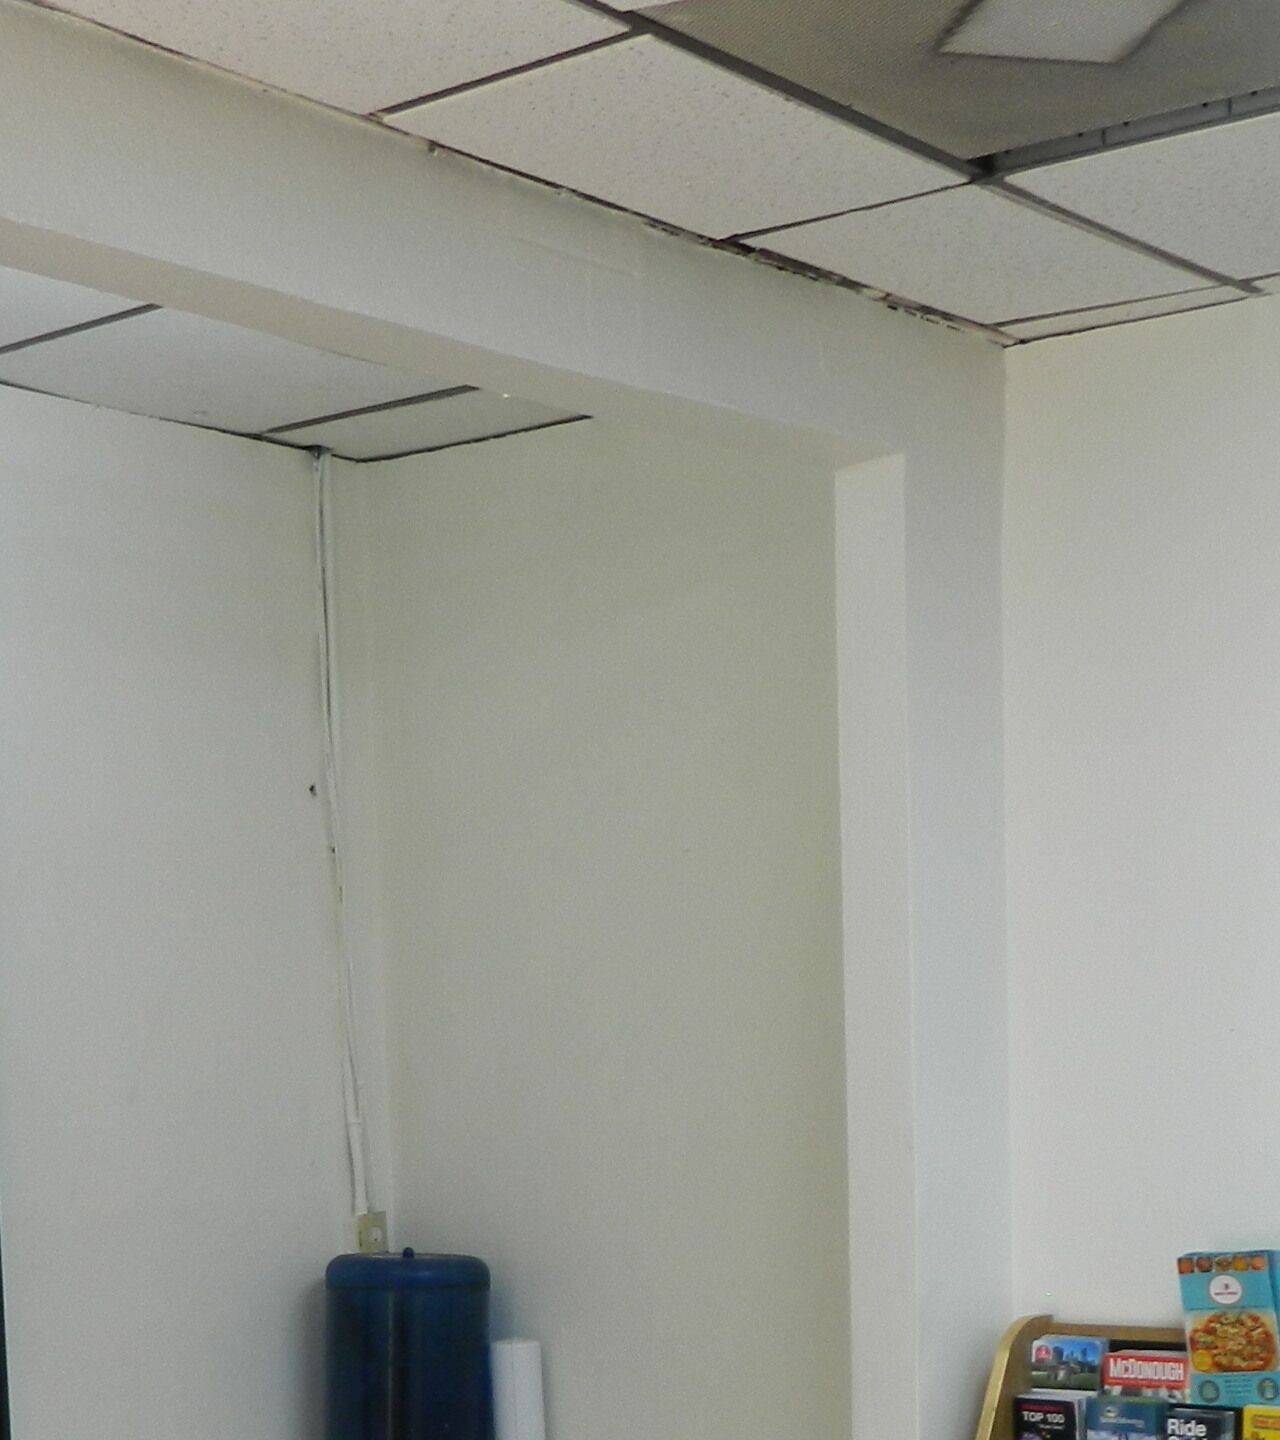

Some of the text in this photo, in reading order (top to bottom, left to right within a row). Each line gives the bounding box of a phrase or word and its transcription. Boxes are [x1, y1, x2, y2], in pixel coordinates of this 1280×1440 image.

[1023, 1411, 1066, 1425] TOP 100
[1167, 1418, 1207, 1437] Ride
